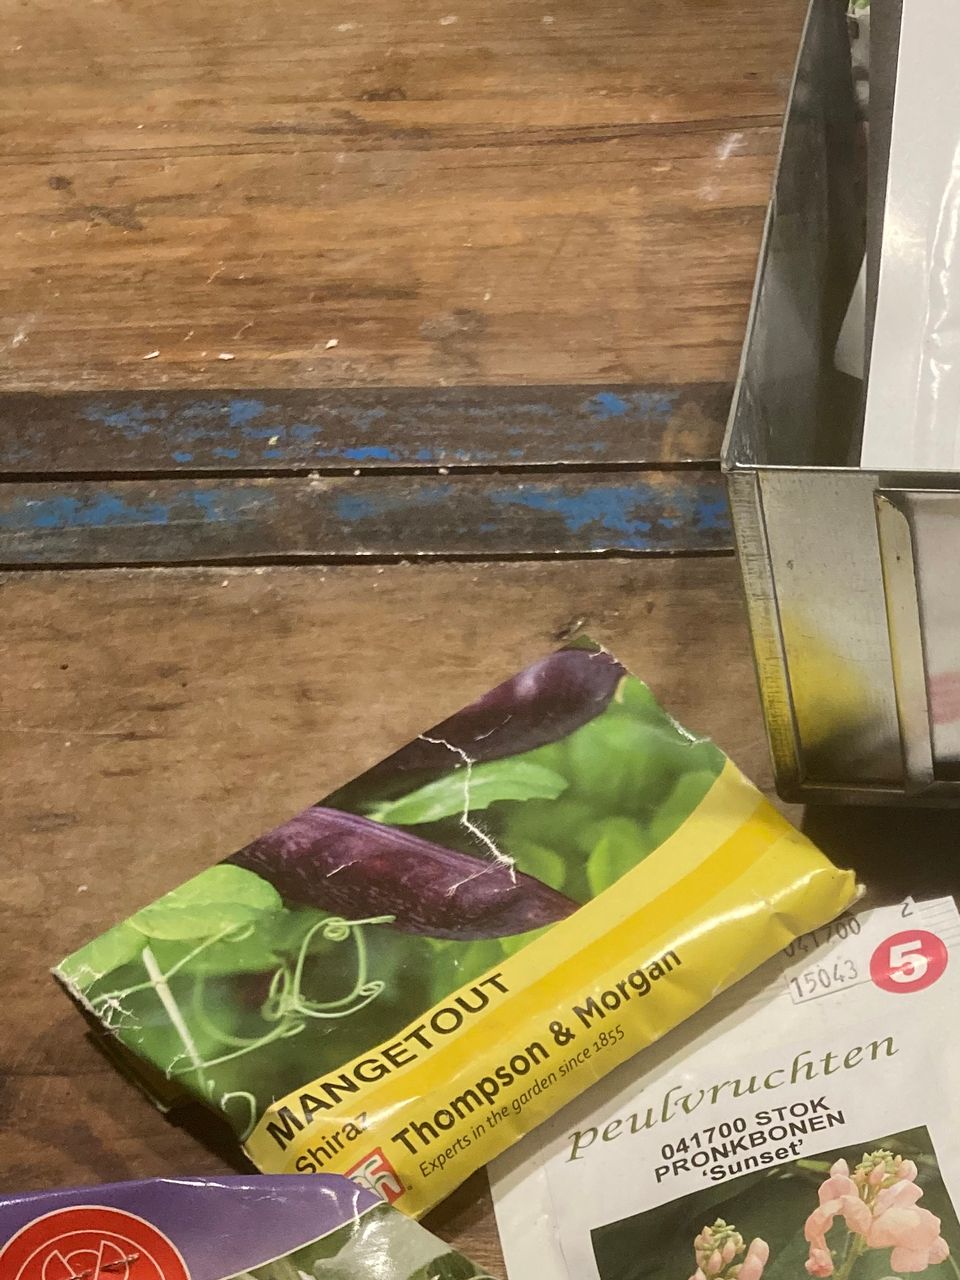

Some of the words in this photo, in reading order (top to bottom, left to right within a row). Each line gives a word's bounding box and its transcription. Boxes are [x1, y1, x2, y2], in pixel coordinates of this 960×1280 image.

[790, 960, 858, 998] 15043
[889, 939, 928, 984] 5
[266, 972, 510, 1151] MANGETOUT
[391, 1041, 550, 1156] Thompson
[549, 1021, 576, 1046] &
[572, 949, 684, 1029] Morgan
[419, 1134, 472, 1178] Experts
[472, 1122, 487, 1141] in
[487, 1105, 510, 1128] the
[512, 1072, 558, 1115] garden
[558, 1047, 592, 1077] since
[594, 1024, 625, 1053] 1855
[566, 1036, 900, 1163] peulvruchten
[661, 1117, 748, 1161] 041700
[754, 1096, 831, 1127] STOK
[295, 1111, 367, 1174] Shiraz
[654, 1110, 847, 1184] PRONKBONEN
